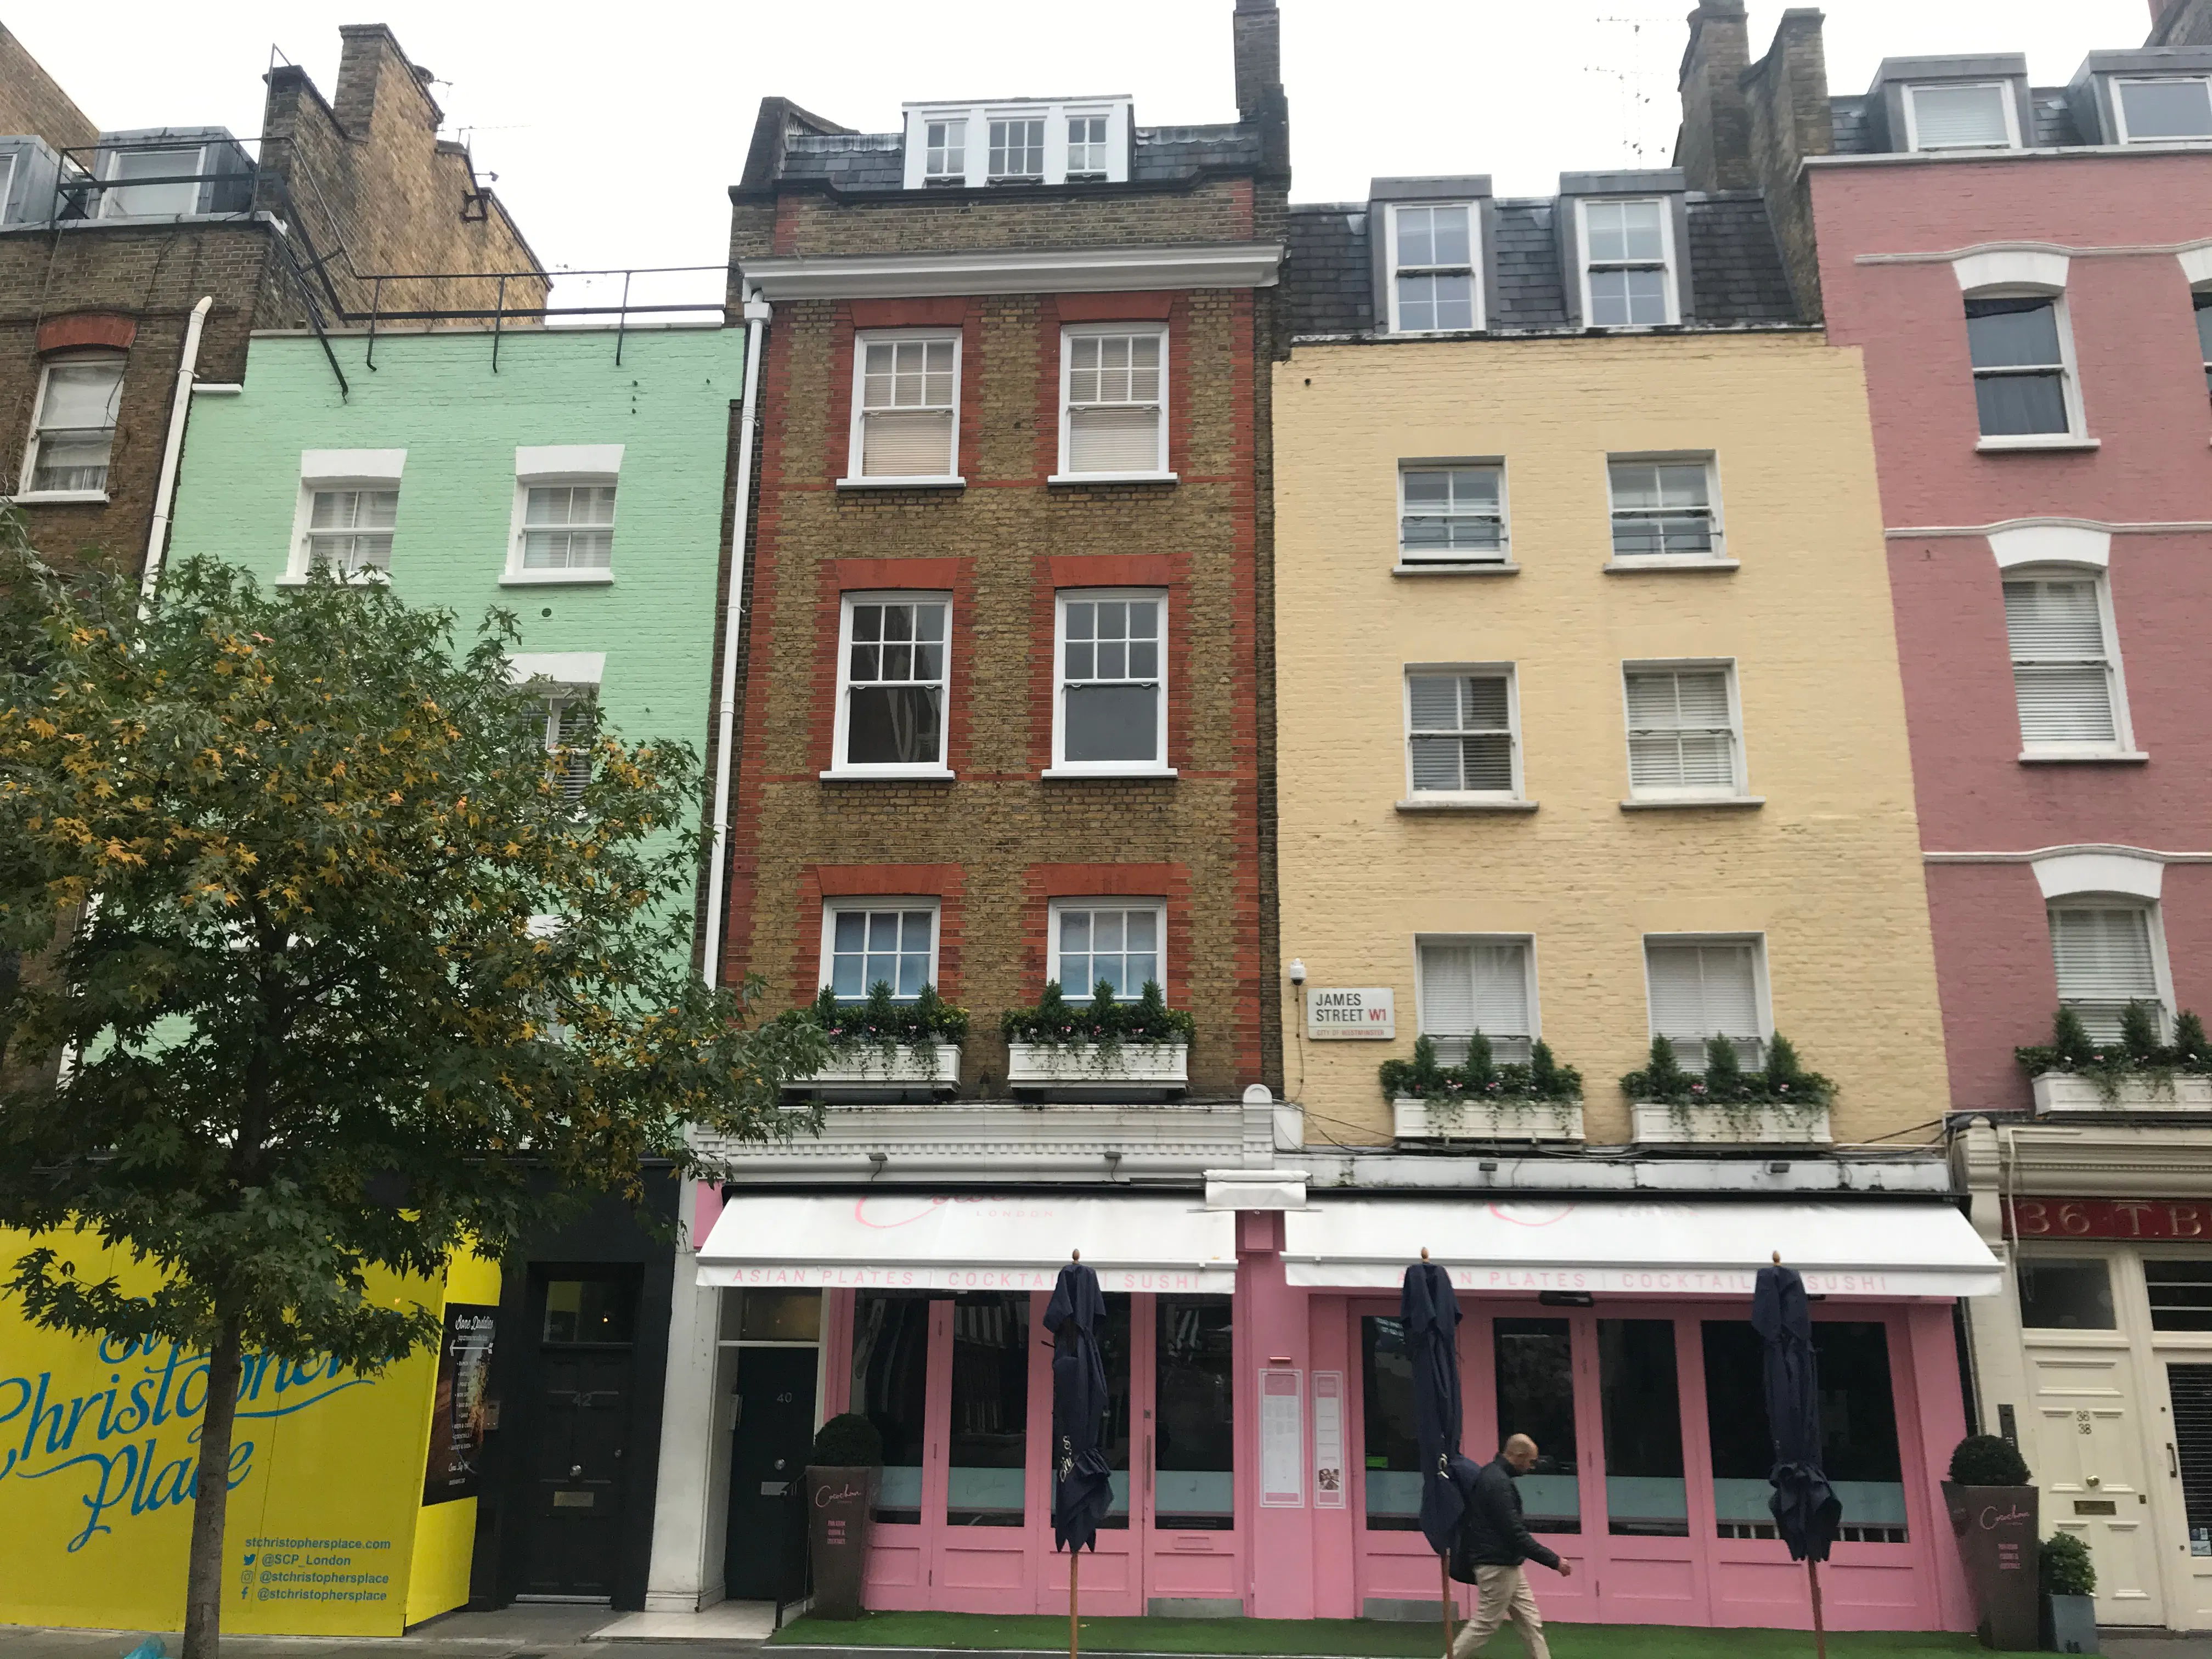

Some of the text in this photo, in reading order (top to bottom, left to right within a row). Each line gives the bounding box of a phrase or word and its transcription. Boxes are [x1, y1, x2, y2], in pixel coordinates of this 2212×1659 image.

[1316, 993, 1362, 1006] JAMES
[1316, 1008, 1387, 1022] STREET W1
[2018, 1202, 2091, 1235] 36
[732, 1268, 1199, 1289] ASIAN PLATES COCKTAI SUSHI
[1489, 1271, 1586, 1288] PLATES
[1622, 1273, 1752, 1289] COCKTAIL
[1807, 1274, 1887, 1291] SUSHI
[776, 1392, 792, 1403] 40
[245, 1537, 391, 1551] stchristophersplace.com
[261, 1553, 351, 1568] @SCP_London
[259, 1570, 390, 1586] @stchristophersplace
[257, 1587, 387, 1602] @stchristophersplace
